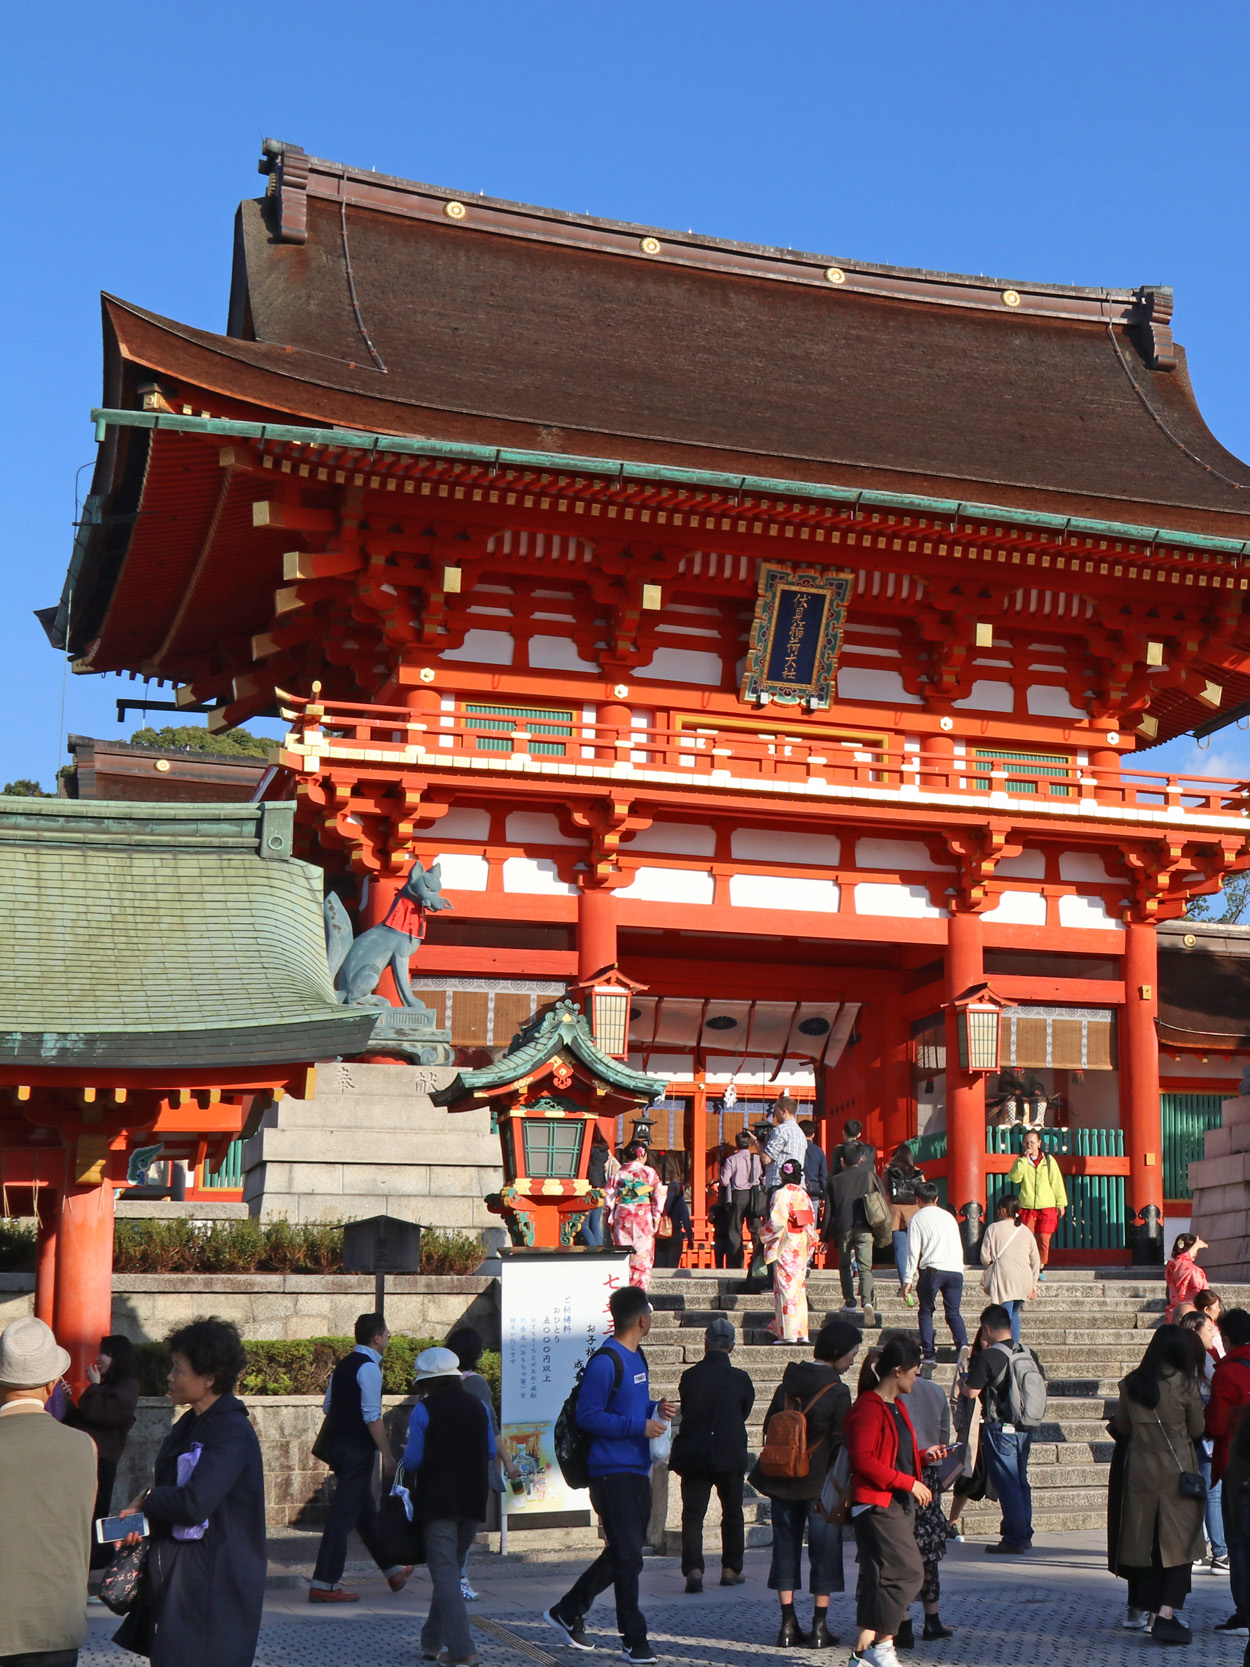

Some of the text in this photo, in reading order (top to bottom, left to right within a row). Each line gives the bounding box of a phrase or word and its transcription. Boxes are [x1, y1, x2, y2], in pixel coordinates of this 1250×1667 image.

[781, 593, 812, 680] 伏見稲荷大社
[553, 1307, 561, 1343] おひとり
